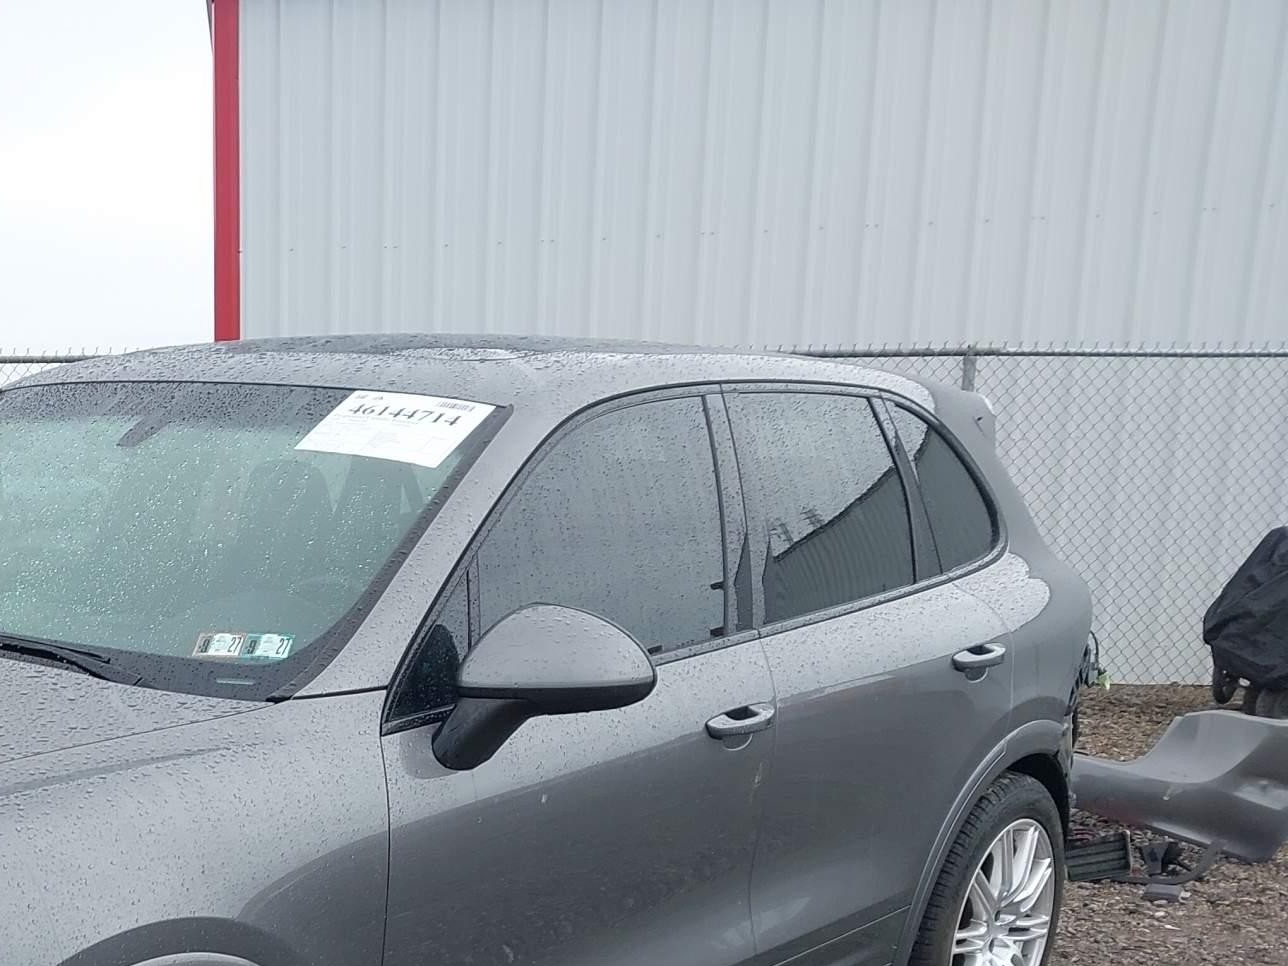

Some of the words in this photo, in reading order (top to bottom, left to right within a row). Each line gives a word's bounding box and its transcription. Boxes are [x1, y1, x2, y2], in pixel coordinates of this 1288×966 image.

[349, 403, 461, 426] 46144714
[227, 636, 243, 653] 27
[275, 637, 291, 656] 27
